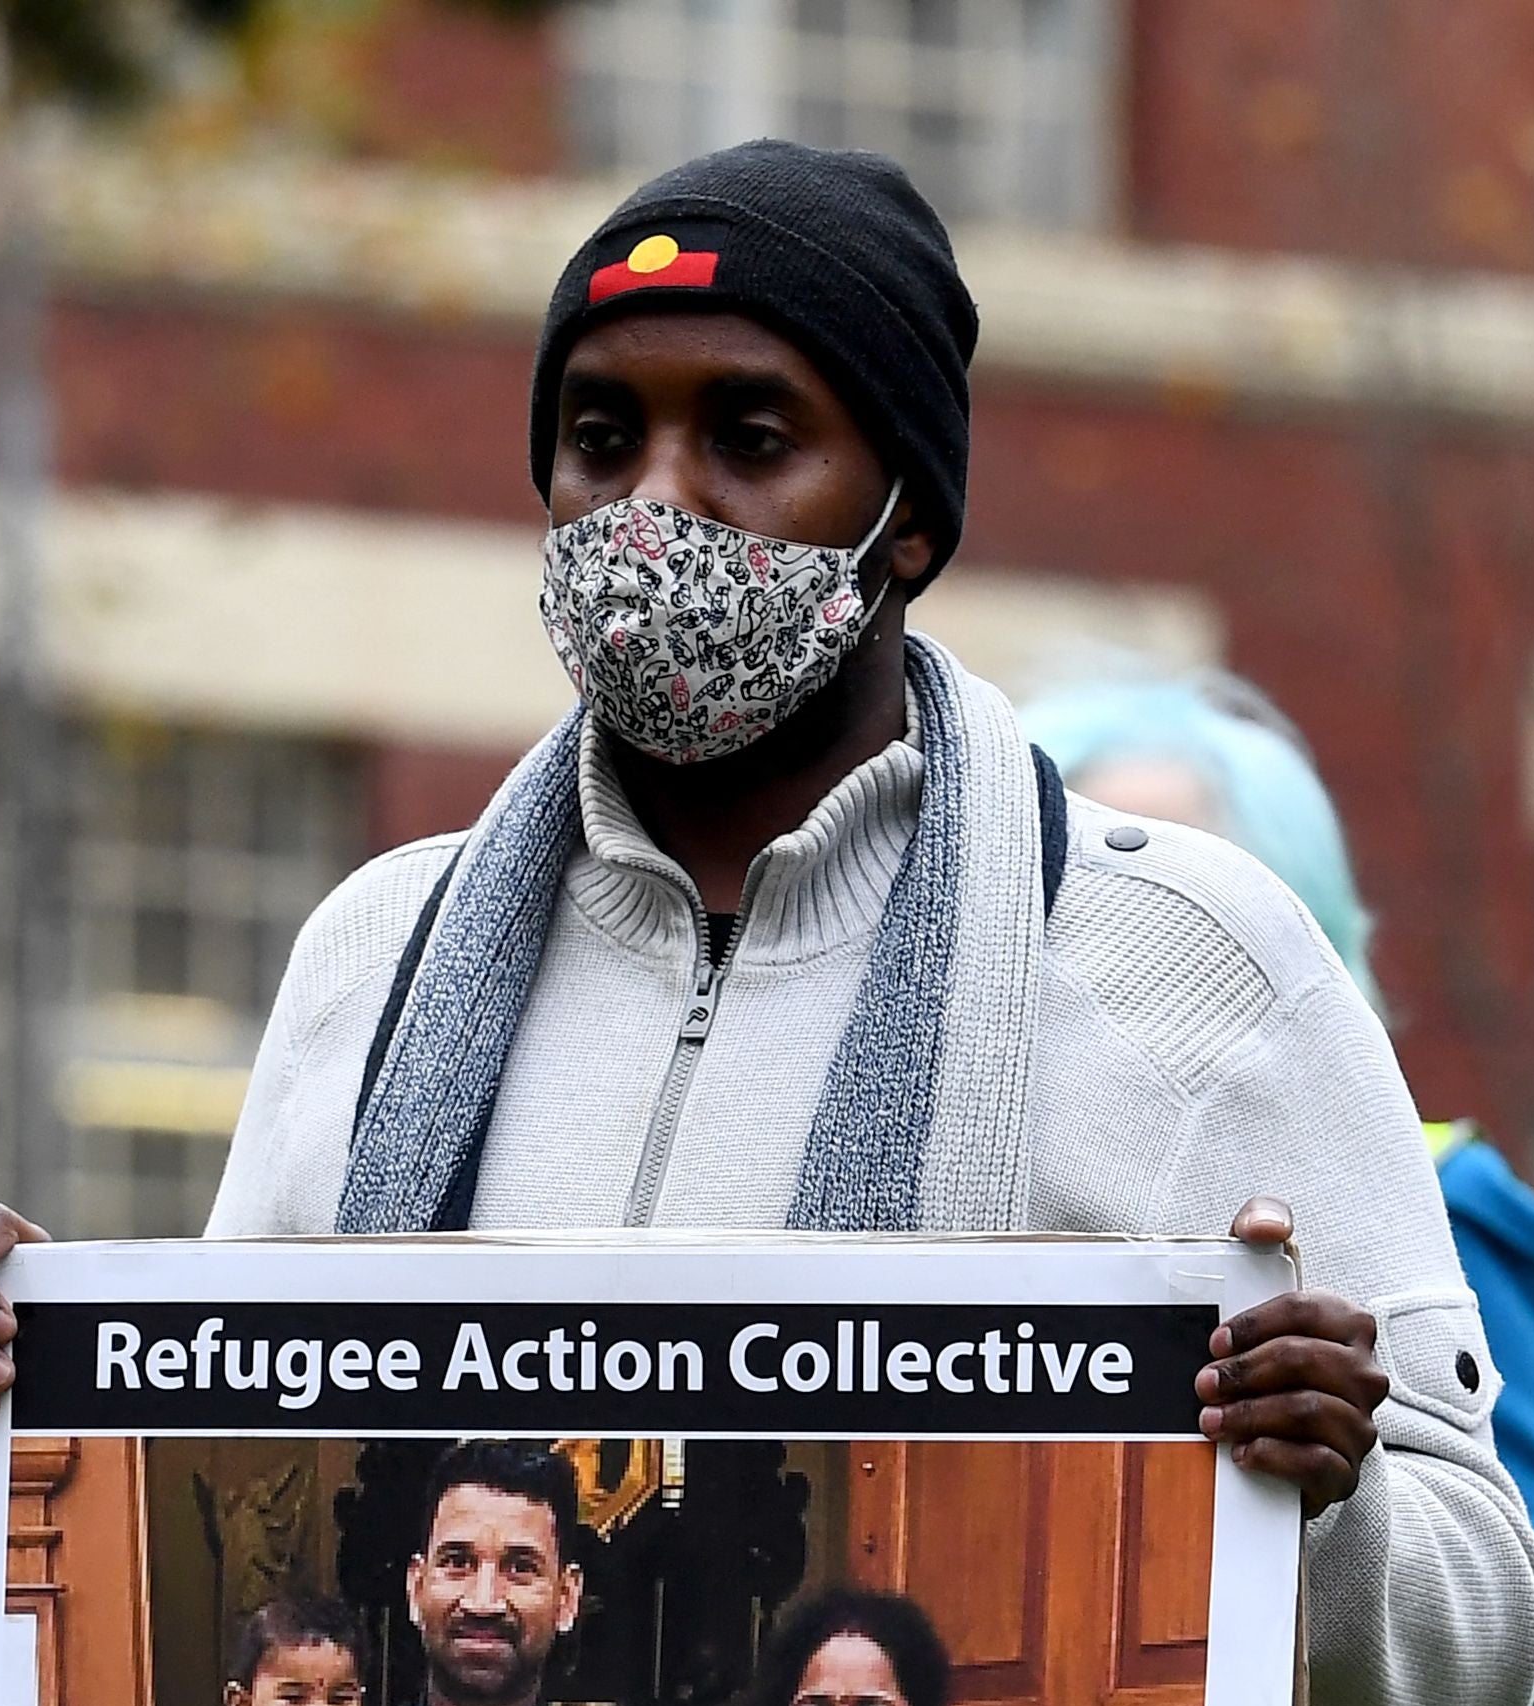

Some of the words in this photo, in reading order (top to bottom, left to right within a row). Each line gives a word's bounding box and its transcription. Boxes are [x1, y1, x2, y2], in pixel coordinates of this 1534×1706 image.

[96, 1317, 421, 1410] Refugee
[442, 1320, 704, 1392] Action
[729, 1320, 1133, 1394] Collective
